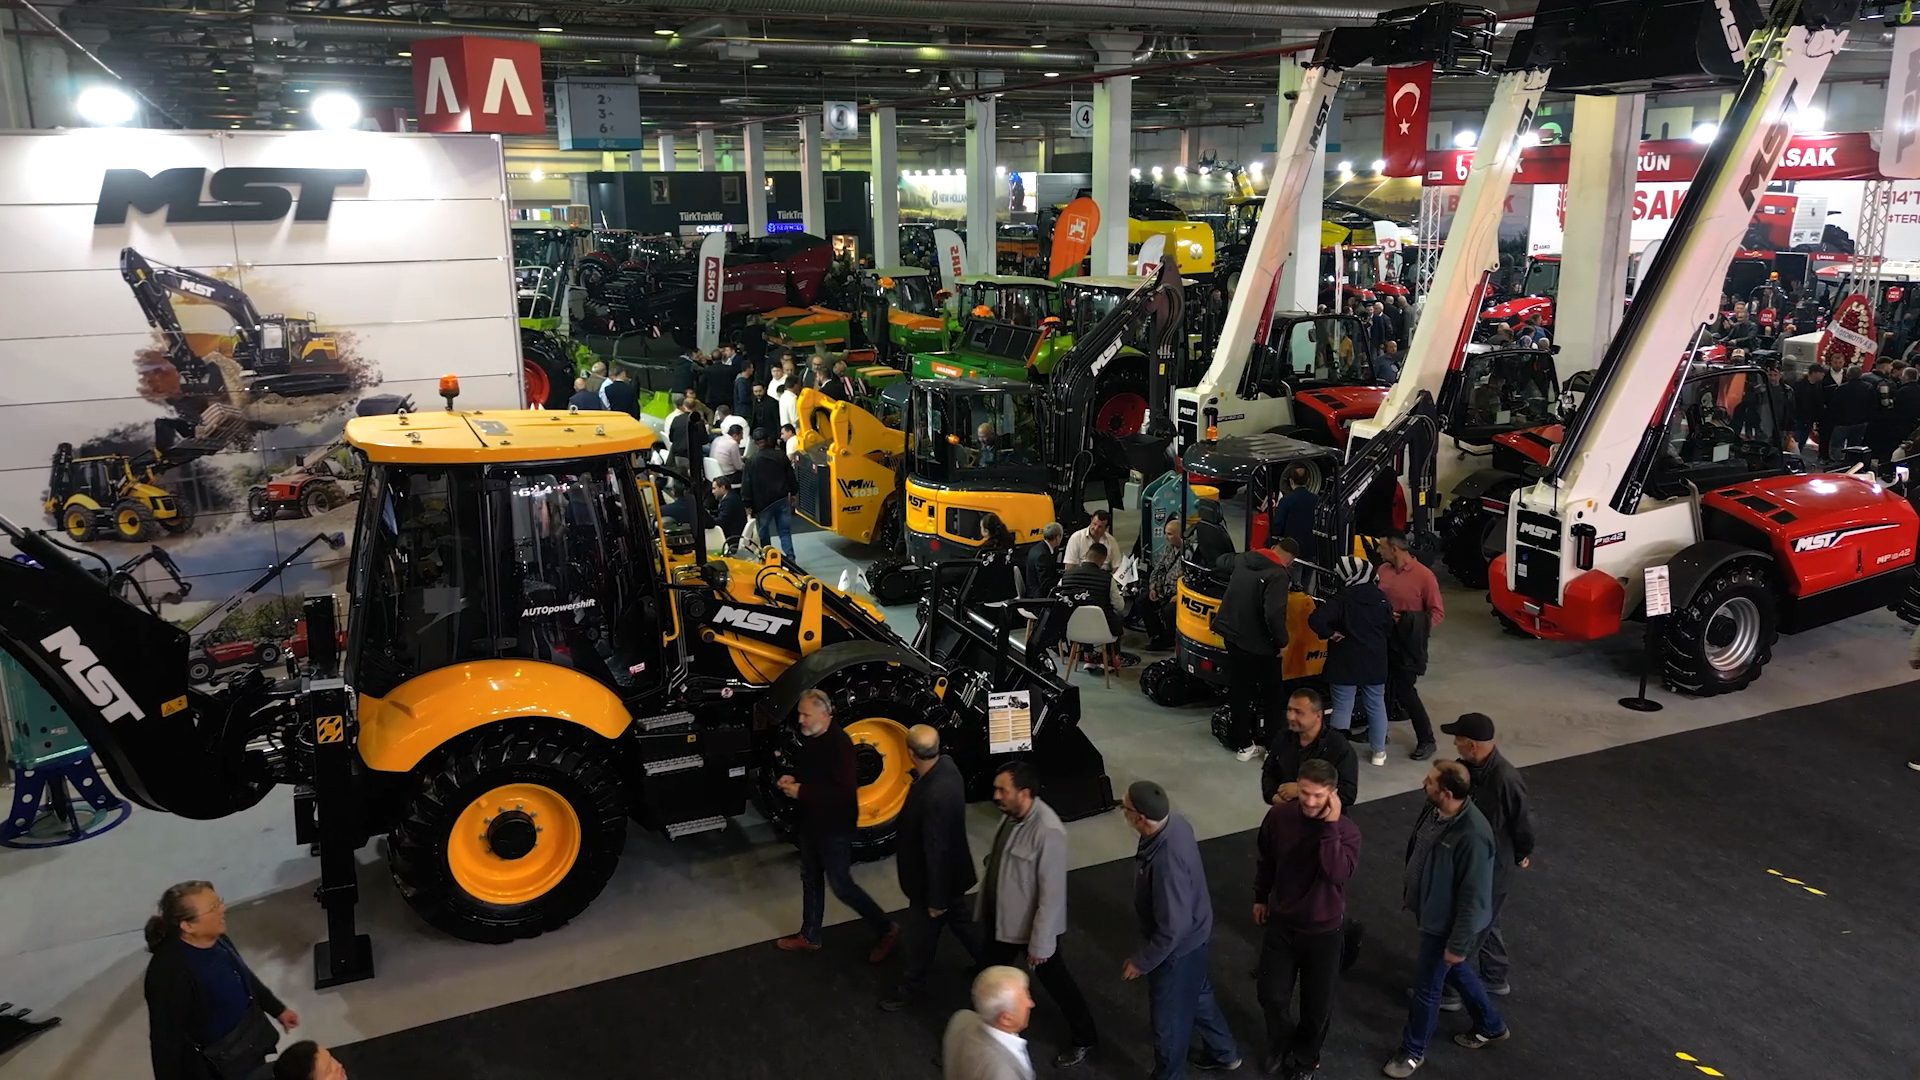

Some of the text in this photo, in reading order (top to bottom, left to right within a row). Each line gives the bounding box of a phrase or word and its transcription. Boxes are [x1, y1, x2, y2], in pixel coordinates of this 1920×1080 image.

[597, 94, 606, 105] 2
[598, 108, 607, 119] 3
[1082, 109, 1090, 124] 4
[600, 123, 608, 134] 6
[94, 167, 367, 225] MST
[680, 211, 723, 221] TürkTraktör
[696, 224, 723, 233] CASE
[180, 279, 216, 297] MST
[708, 260, 716, 300] ASKO
[1090, 330, 1122, 377] MST
[1520, 522, 1557, 540] MST
[1795, 532, 1837, 552] MST
[521, 598, 596, 618] AUTOpowershift
[1182, 594, 1215, 616] MST
[712, 605, 793, 635] MST
[39, 625, 146, 724] MST
